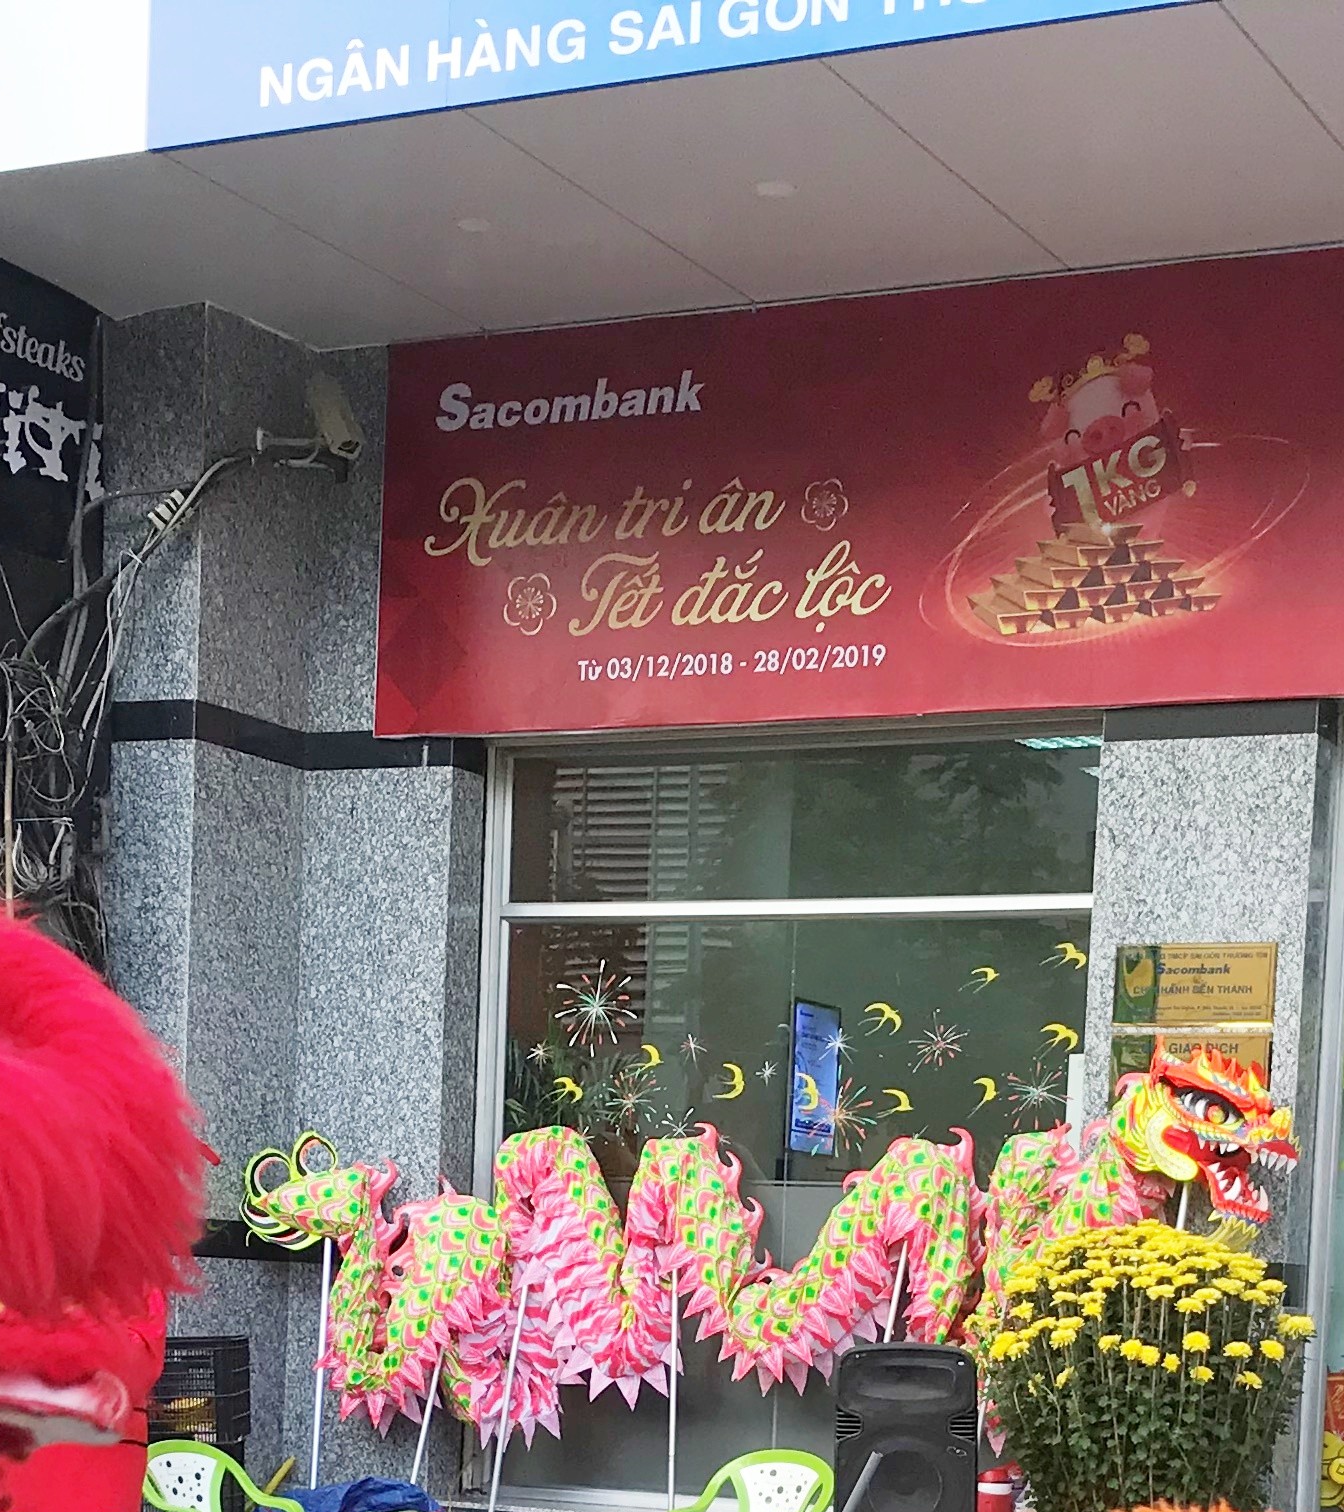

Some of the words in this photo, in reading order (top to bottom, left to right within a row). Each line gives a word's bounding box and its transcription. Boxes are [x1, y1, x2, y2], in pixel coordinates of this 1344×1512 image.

[260, 38, 410, 107] NGÂN
[427, 18, 586, 83] HÀNG
[436, 370, 705, 433] Sacombank
[424, 477, 608, 567] Xuân
[614, 478, 693, 540] tri
[698, 475, 786, 536] ân
[1103, 479, 1162, 516] VÀNG
[568, 551, 664, 638] Tết
[671, 548, 789, 627] đắc
[794, 539, 893, 634] lộc
[578, 659, 603, 682] Từ
[606, 651, 734, 684] 03/12/2018
[754, 644, 887, 677] 28/02/2019
[1157, 963, 1231, 975] Sacombank
